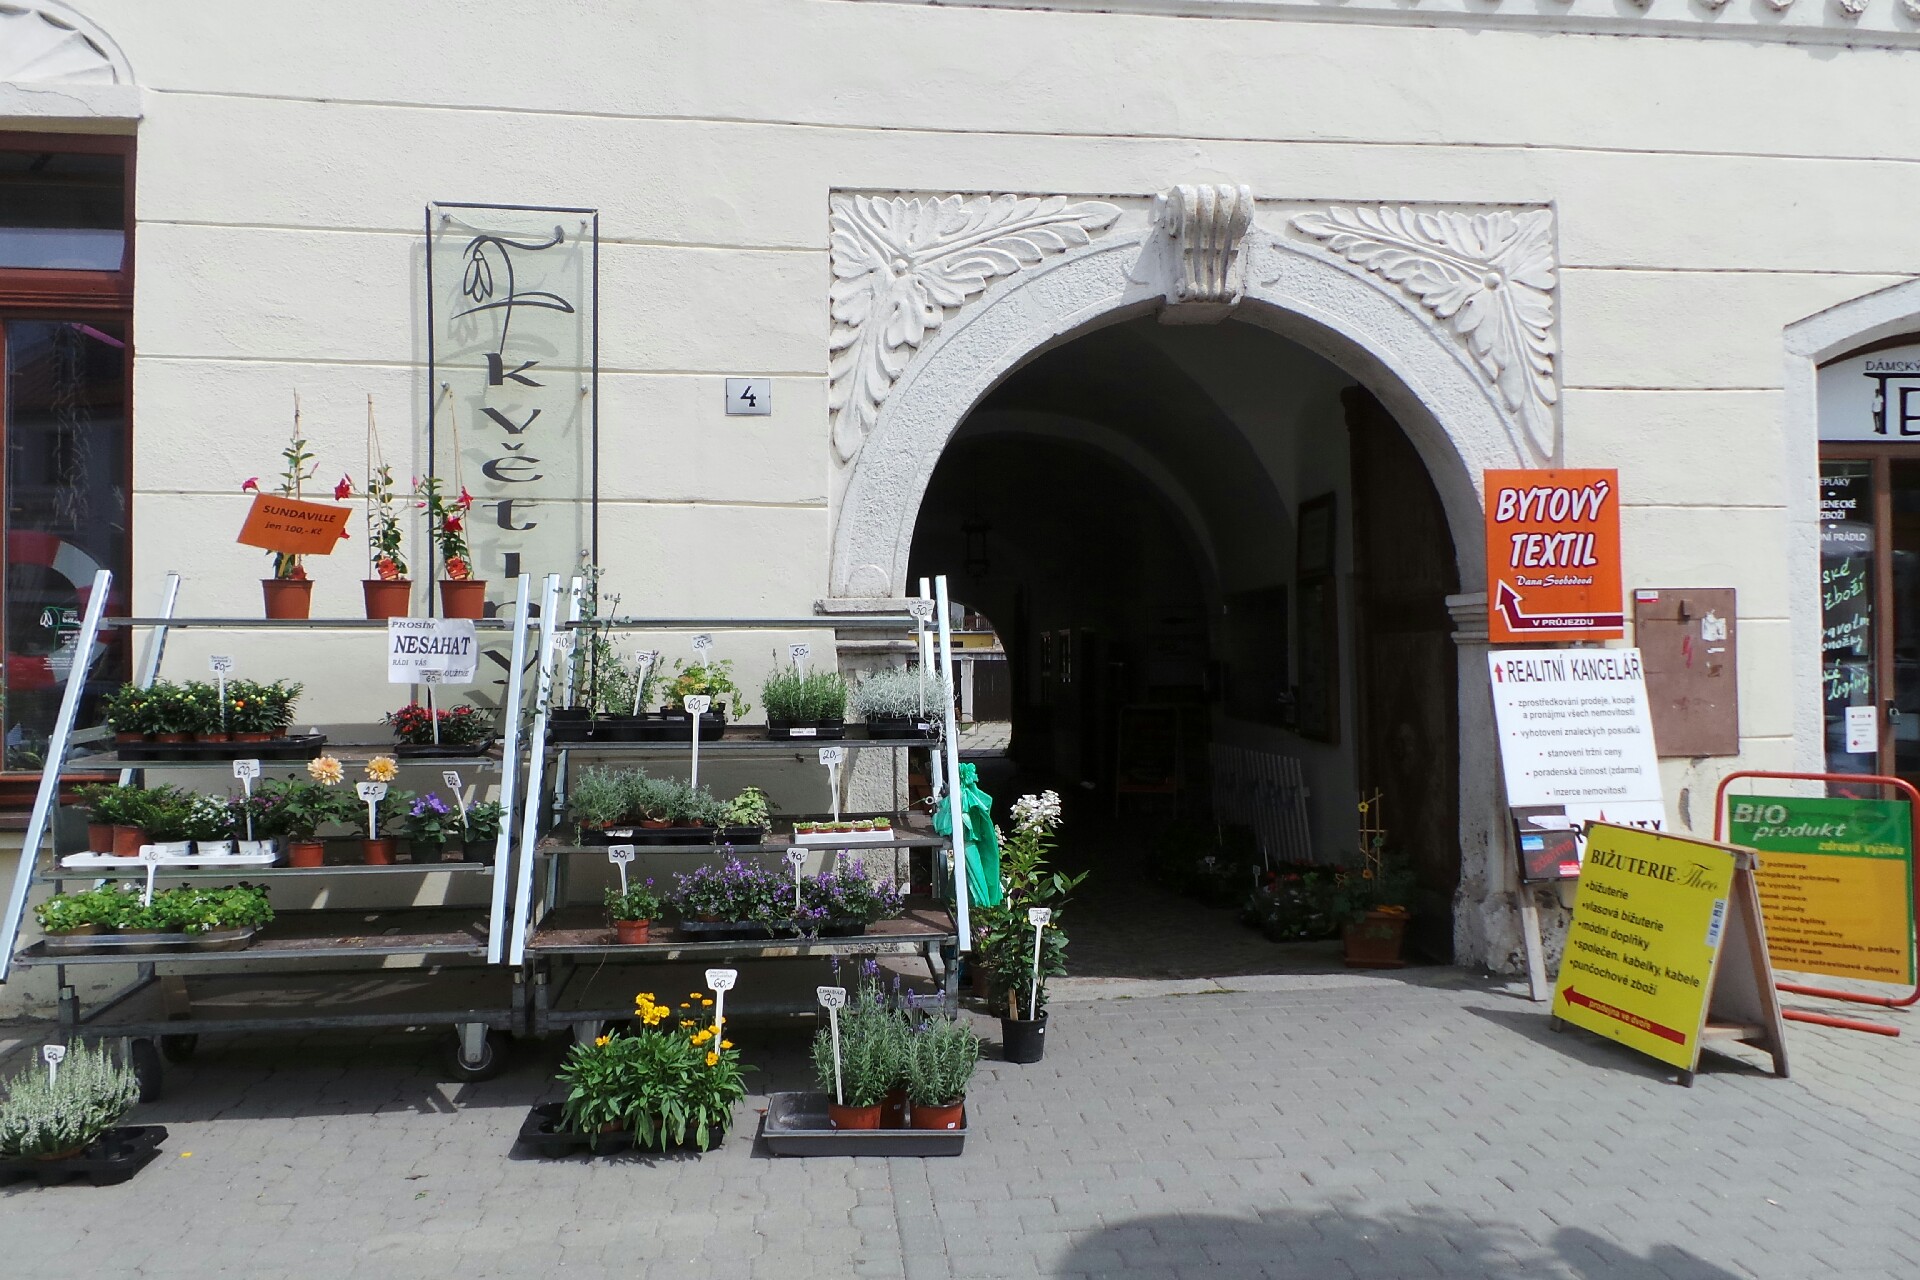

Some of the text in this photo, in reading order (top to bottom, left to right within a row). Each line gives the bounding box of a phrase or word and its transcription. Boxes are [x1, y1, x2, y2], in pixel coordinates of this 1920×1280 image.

[740, 384, 757, 408] 4
[1495, 480, 1610, 523] BYTOVÝ
[263, 505, 336, 523] SUNDAVILLE
[265, 521, 281, 530] jen
[1510, 530, 1599, 569] TEXTIL
[1516, 574, 1593, 587] Dana Svobodová
[391, 620, 435, 629] PROSÍM
[1542, 617, 1594, 626] PRŮJEZDU
[394, 634, 471, 655] NESAHAT
[1506, 652, 1642, 683] REALITNÍ KANCELÁŘ
[688, 698, 708, 712] 60,-
[1568, 709, 1589, 718] všech
[823, 750, 841, 761] 20,-
[1604, 748, 1622, 758] ceny
[363, 786, 383, 798] 25,-
[1733, 803, 1787, 824] BIO
[1752, 822, 1846, 841] produkt
[612, 849, 630, 860] 30,-
[1530, 839, 1575, 873] zdarma
[1590, 849, 1677, 883] BIŽUTERIE
[1589, 880, 1629, 900] bižuterie
[1585, 901, 1664, 932] vlasová bižuterie
[1581, 921, 1650, 951] módní doplňky
[714, 978, 732, 989] 60,-
[1572, 960, 1658, 996] punčochové zboží
[1665, 966, 1700, 988] kabele
[824, 994, 841, 1007] 90,-
